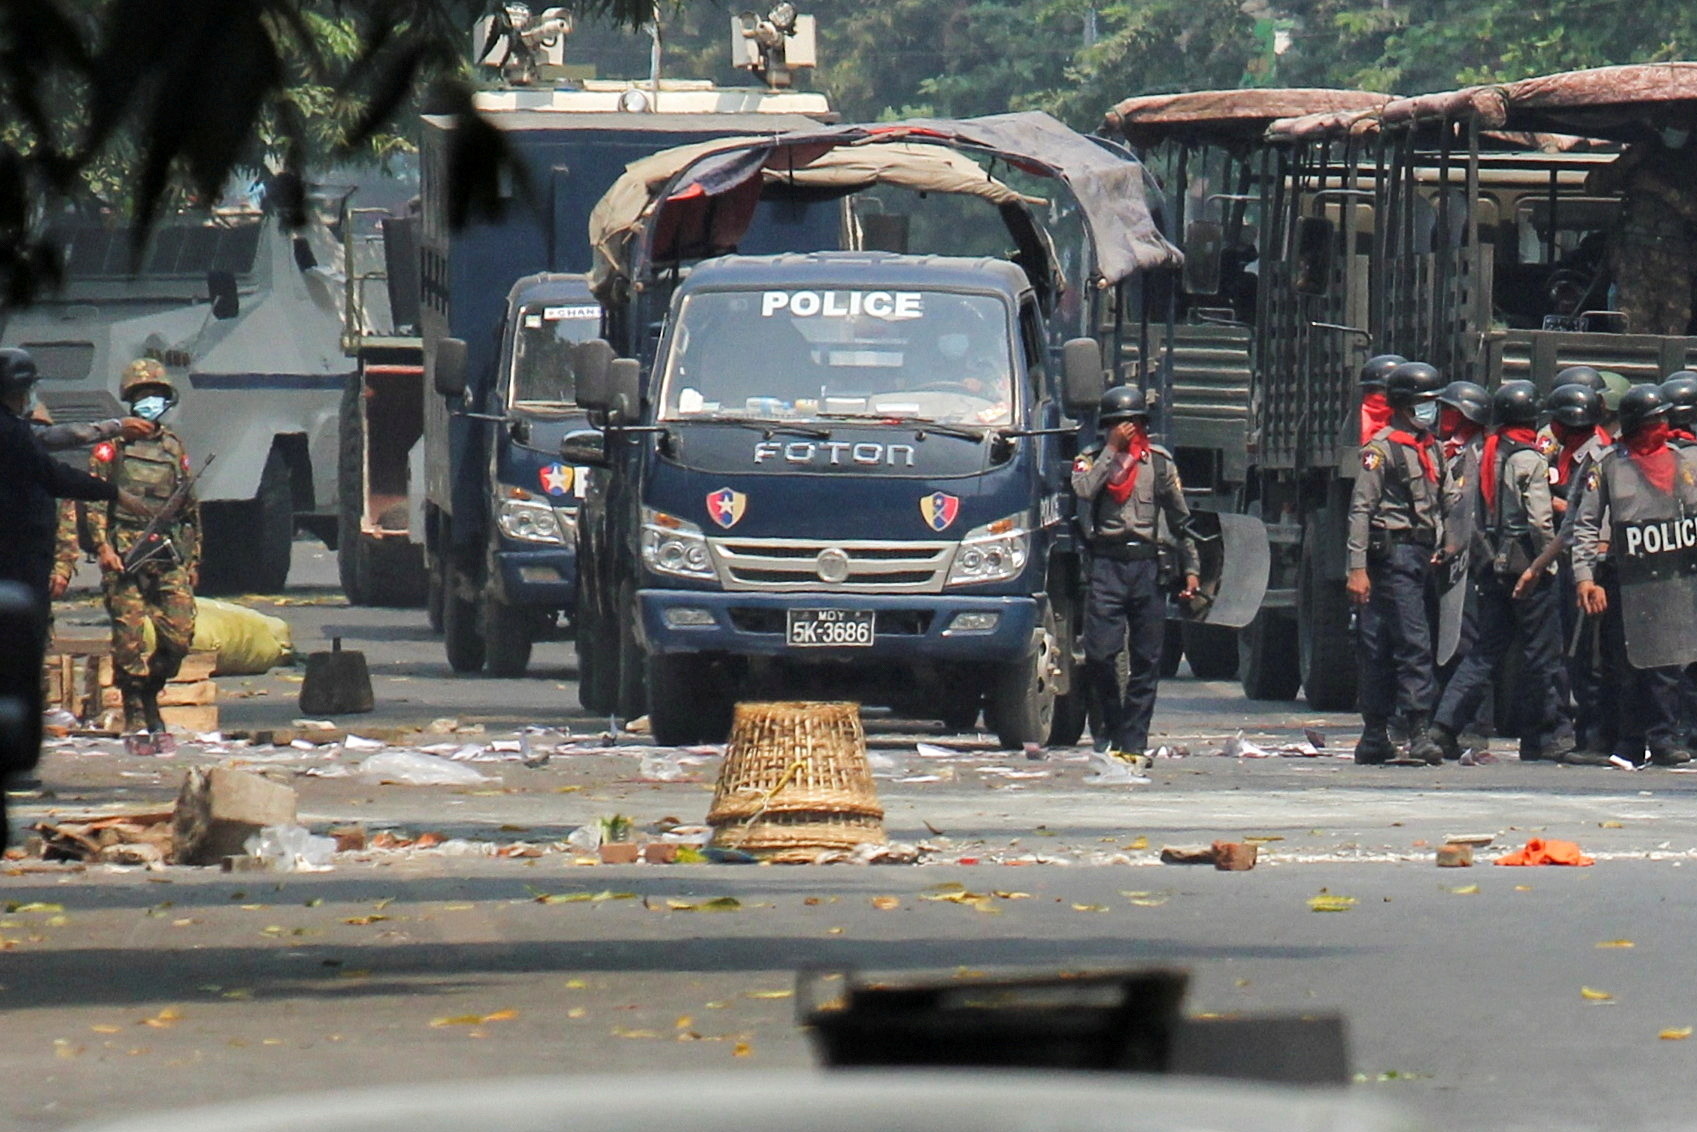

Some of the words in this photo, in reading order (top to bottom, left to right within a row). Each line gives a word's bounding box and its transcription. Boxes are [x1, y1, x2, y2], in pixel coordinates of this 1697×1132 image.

[761, 290, 924, 318] POLICE
[753, 441, 915, 466] FOTON
[818, 610, 846, 621] MDY
[792, 621, 870, 643] 5K-3686
